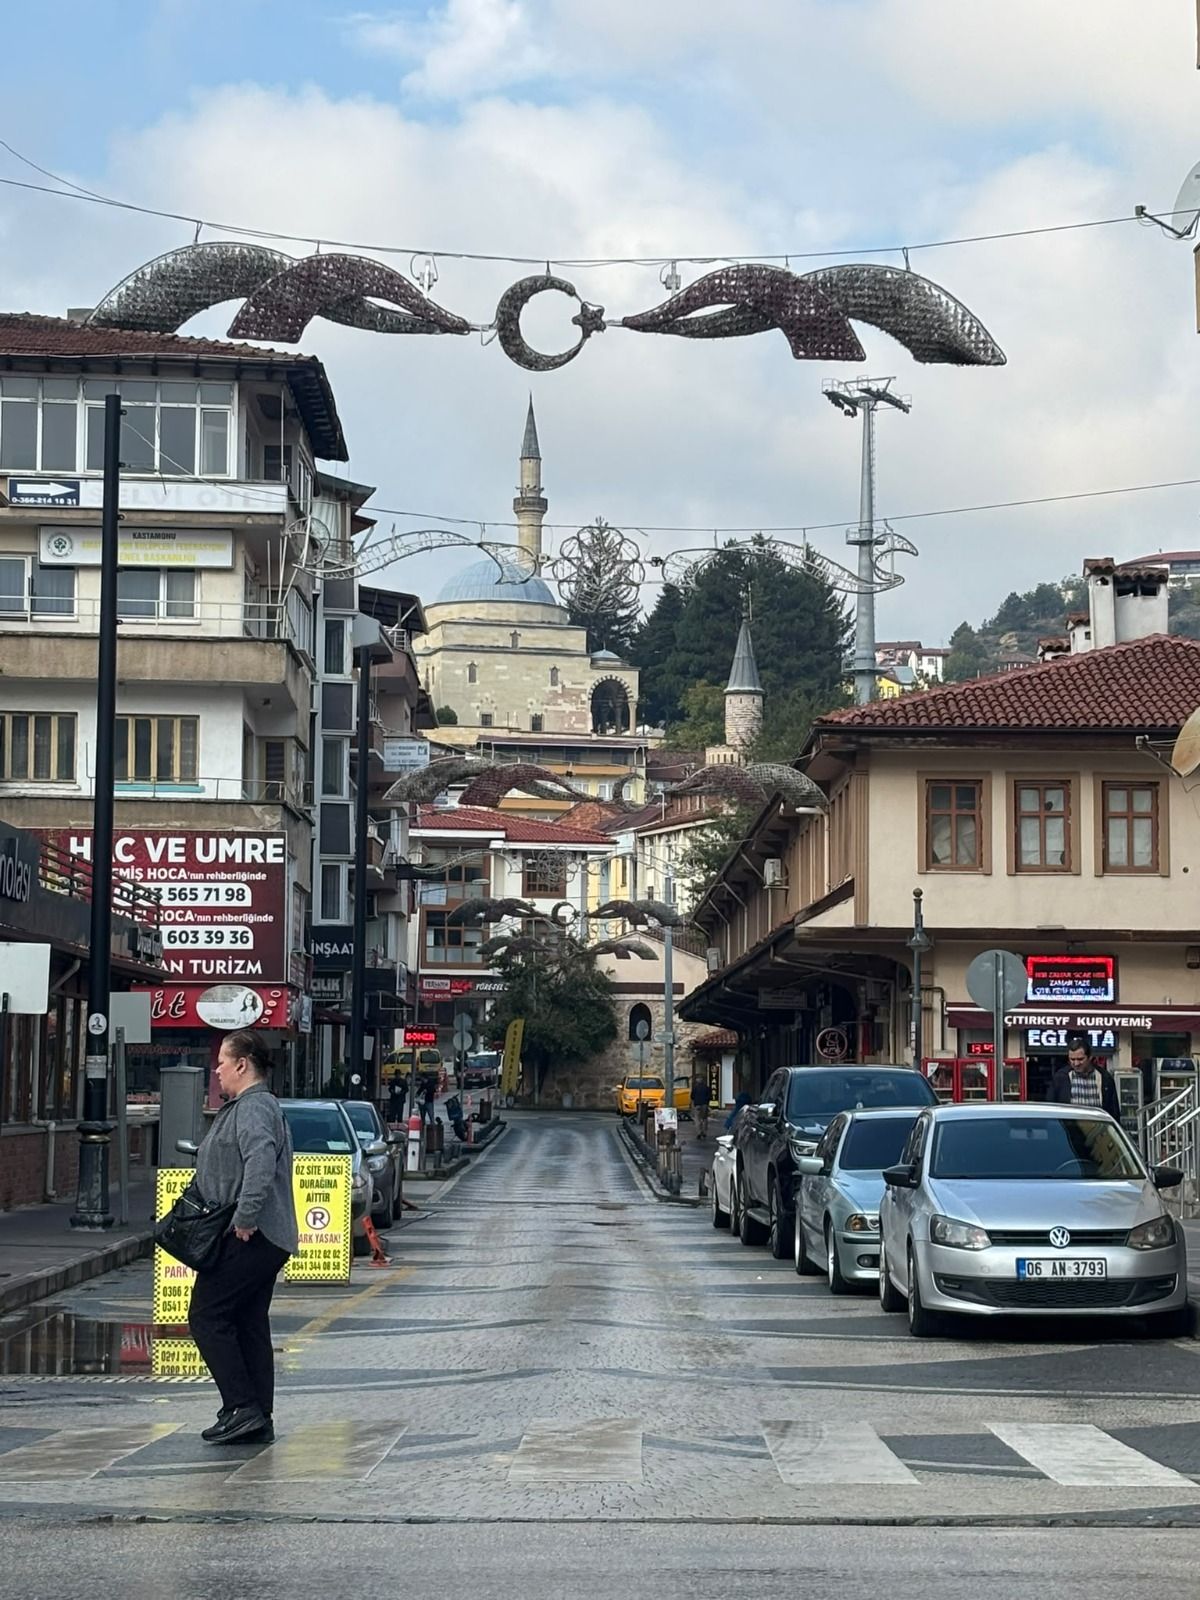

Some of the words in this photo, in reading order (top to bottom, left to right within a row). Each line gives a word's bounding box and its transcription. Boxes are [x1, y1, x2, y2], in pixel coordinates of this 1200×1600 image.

[132, 532, 176, 540] KASTAMONU
[70, 837, 136, 863] HC
[144, 838, 186, 863] VE
[195, 838, 285, 864] UMRE
[206, 871, 267, 881] rehberliğinde
[168, 887, 199, 901] 565
[203, 887, 220, 901] 71
[225, 887, 246, 901] 98
[213, 913, 274, 923] rehberliğinde
[167, 930, 199, 944] 603
[204, 930, 225, 944] 39
[230, 930, 250, 944] 36
[189, 956, 262, 974] TURİZM
[1004, 1015, 1070, 1027] ÇITIRKEYF
[1077, 1016, 1152, 1029] KURUYEMİŞ
[1087, 1030, 1115, 1047] TA
[296, 1164, 305, 1175] ÖZ
[306, 1163, 321, 1175] SİTE
[323, 1163, 343, 1175] TAKSİ
[166, 1179, 178, 1194] ÖZ
[299, 1177, 338, 1189] DURAĞINA
[306, 1191, 330, 1202] AİTTİR
[298, 1233, 313, 1243] ARK
[315, 1233, 341, 1244] YASAK!
[310, 1250, 321, 1259] 212
[333, 1250, 341, 1259] 02
[165, 1266, 188, 1278] PARK
[292, 1262, 308, 1270] 0541
[309, 1262, 321, 1270] 344
[1027, 1262, 1042, 1276] 06
[1051, 1262, 1066, 1276] AN
[1073, 1262, 1104, 1276] 3793
[163, 1286, 182, 1297] 0366
[162, 1301, 181, 1312] 0541
